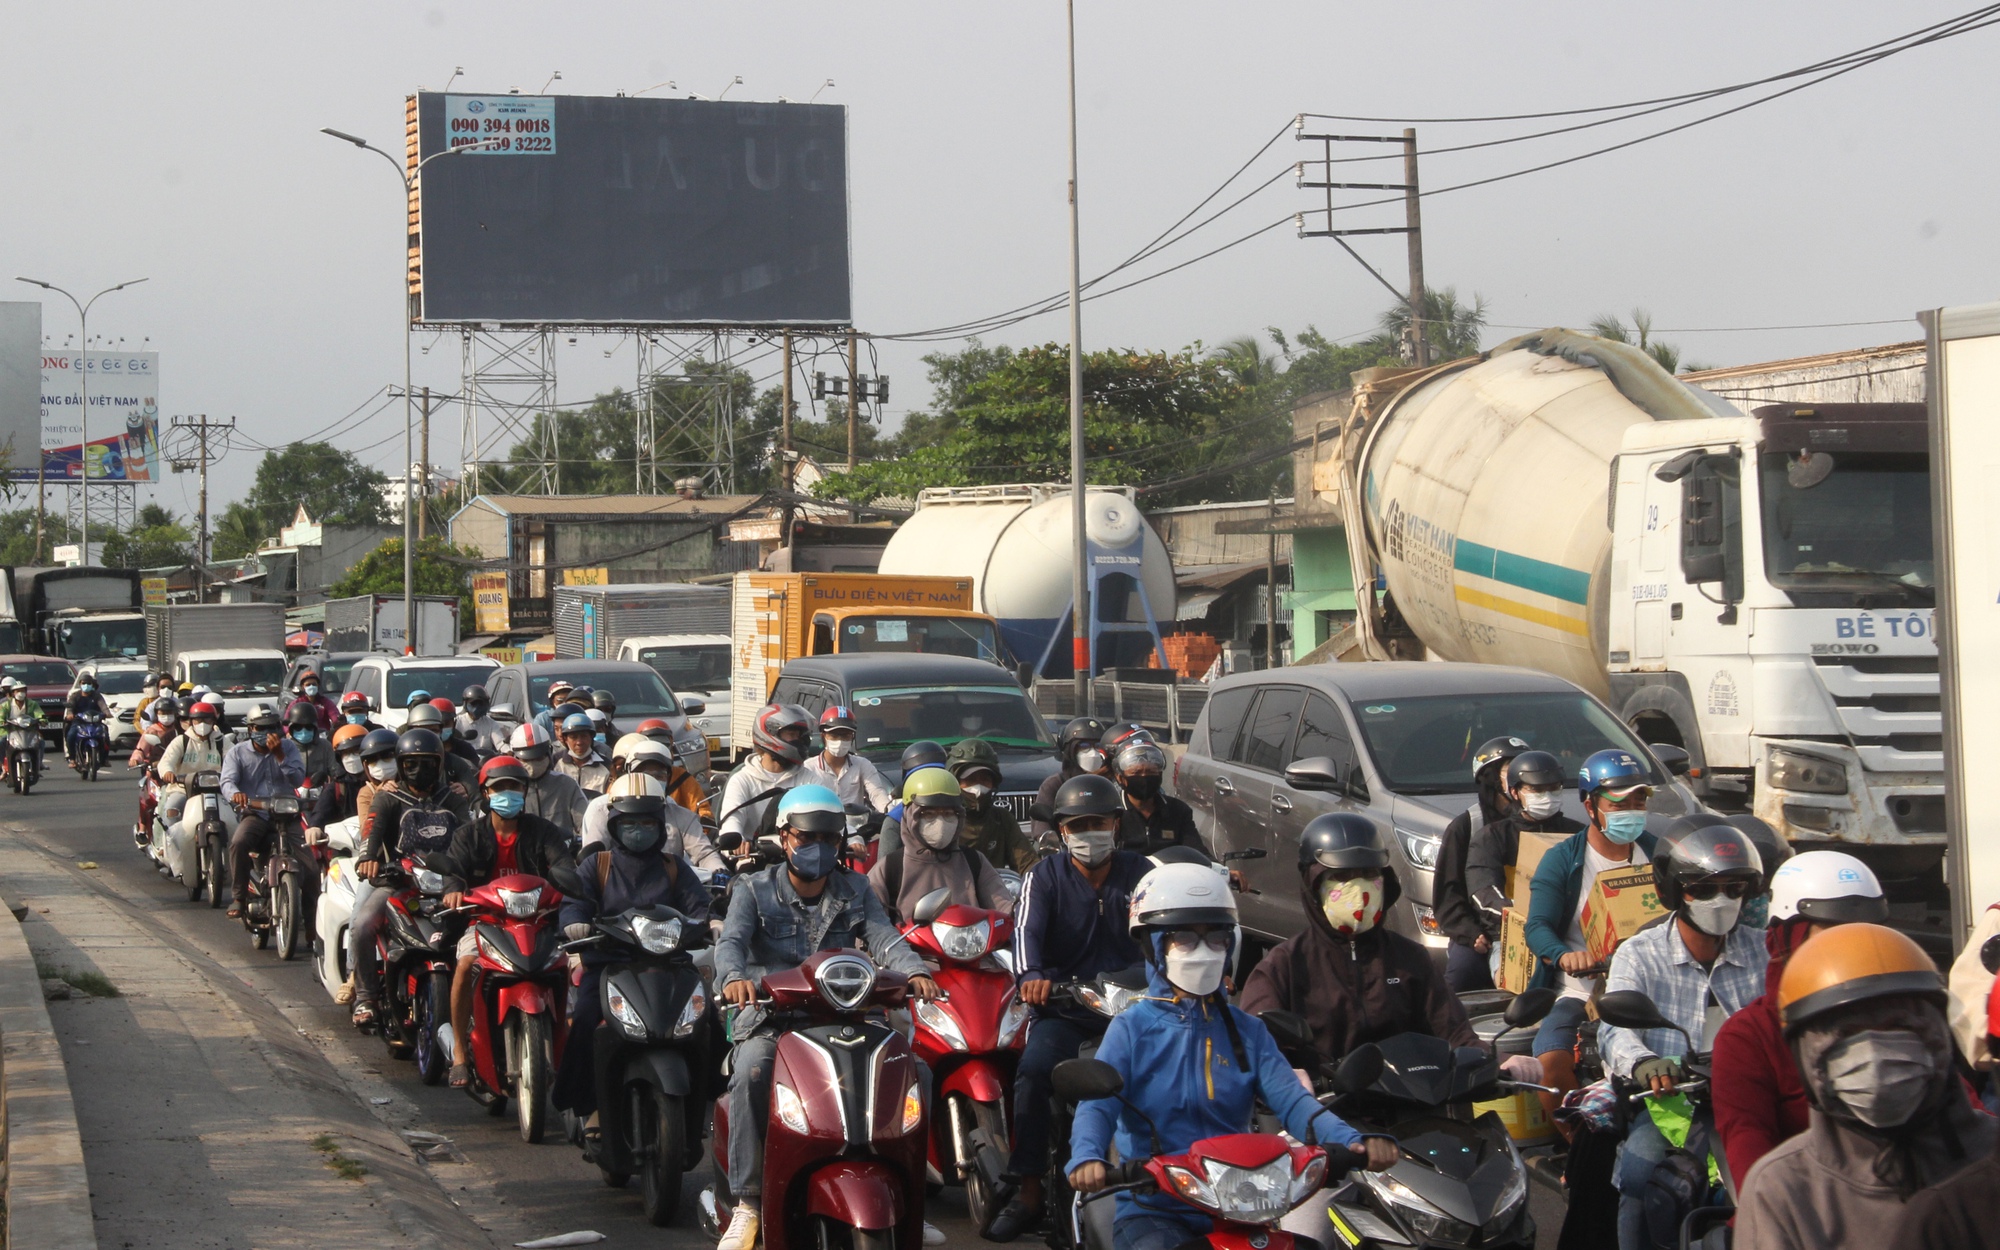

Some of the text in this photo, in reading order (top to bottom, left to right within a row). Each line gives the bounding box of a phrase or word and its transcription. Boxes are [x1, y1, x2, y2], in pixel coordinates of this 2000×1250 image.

[451, 118, 550, 133] 090 394 0018
[515, 137, 552, 151] 3222
[89, 394, 111, 408] VIỆT
[114, 397, 139, 406] NAM
[1646, 504, 1659, 531] 29
[1404, 536, 1452, 568] READY-MIXED
[1405, 550, 1450, 584] CONCRETE
[478, 593, 503, 605] QUANG
[814, 587, 962, 604] BƯU ĐIỆN VIỆT NAM
[1836, 612, 1933, 639] BÊ TÔ
[1810, 643, 1880, 655] HOWO
[1608, 877, 1633, 888] BRAKE
[1407, 1064, 1440, 1073] HONDA
